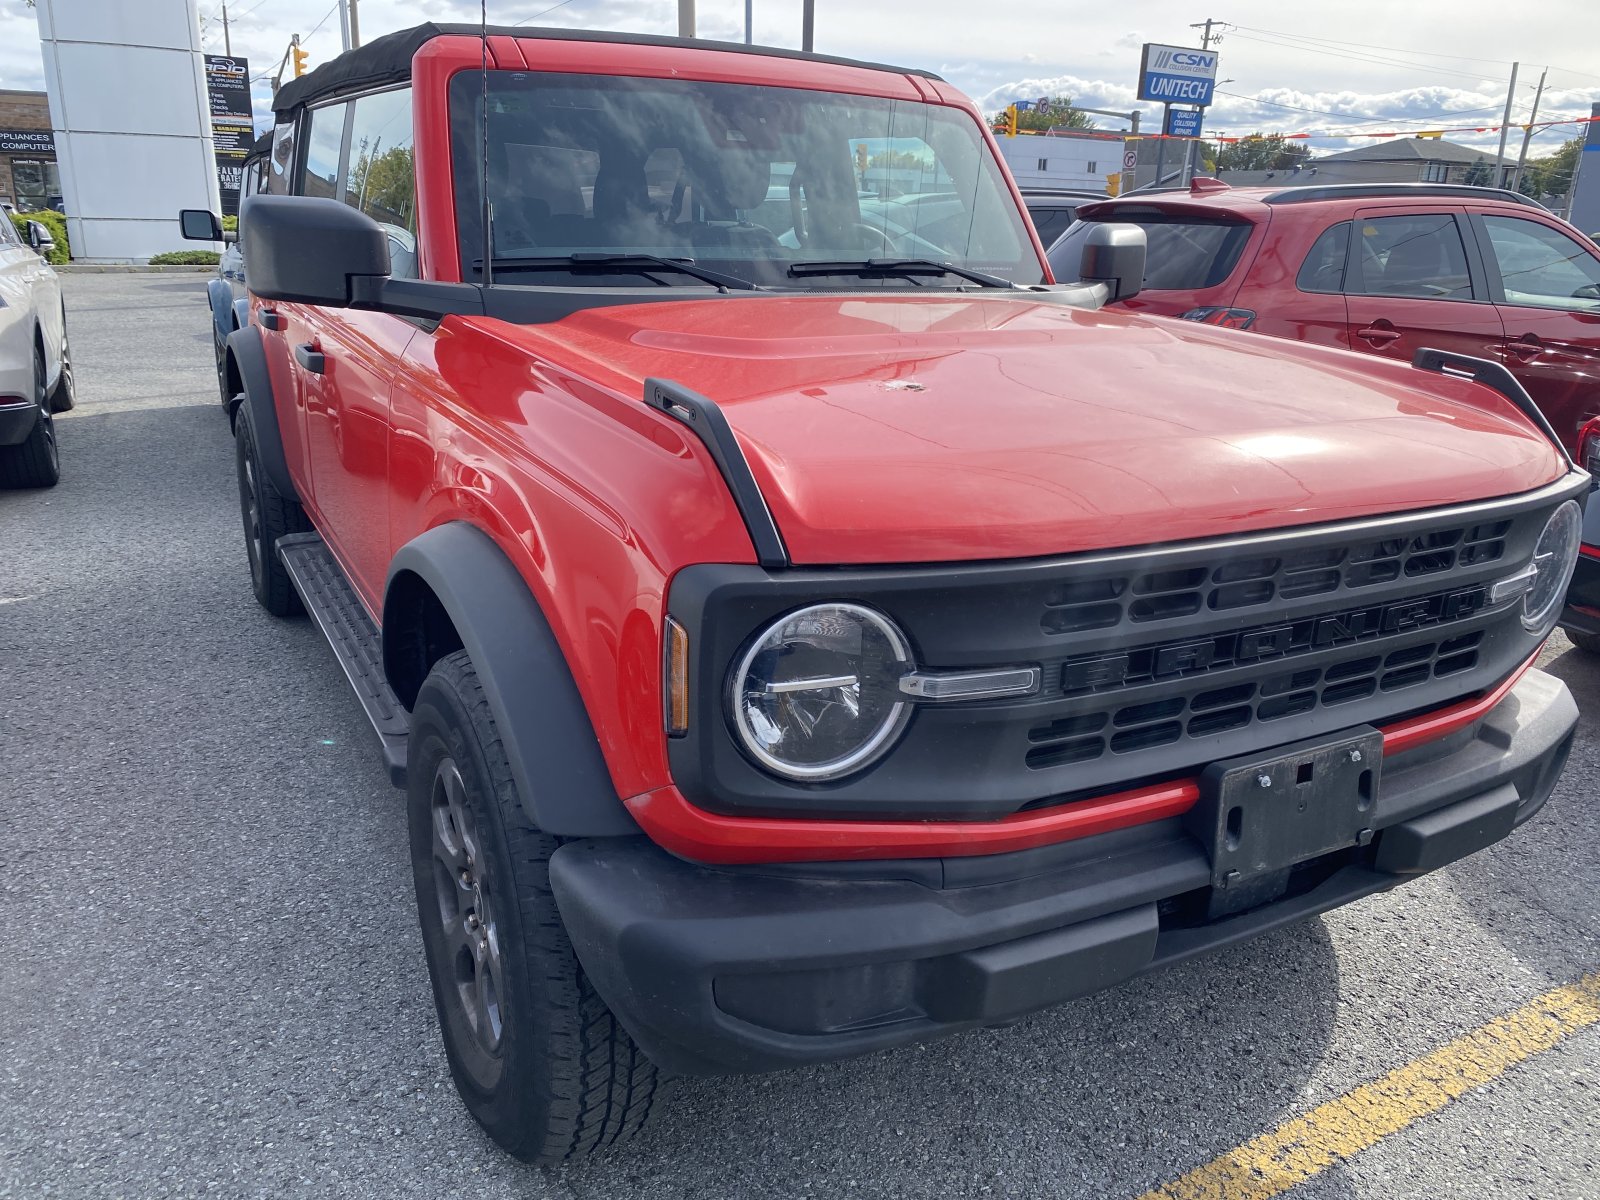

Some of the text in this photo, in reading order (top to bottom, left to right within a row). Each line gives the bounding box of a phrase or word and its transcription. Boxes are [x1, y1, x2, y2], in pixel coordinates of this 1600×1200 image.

[1172, 53, 1214, 68] CSN
[1192, 66, 1210, 74] CENTRE
[1150, 77, 1209, 100] UNITECH
[1177, 111, 1198, 119] QUALITY
[1174, 119, 1197, 127] COLLISION
[1061, 586, 1488, 692] BRONCO
